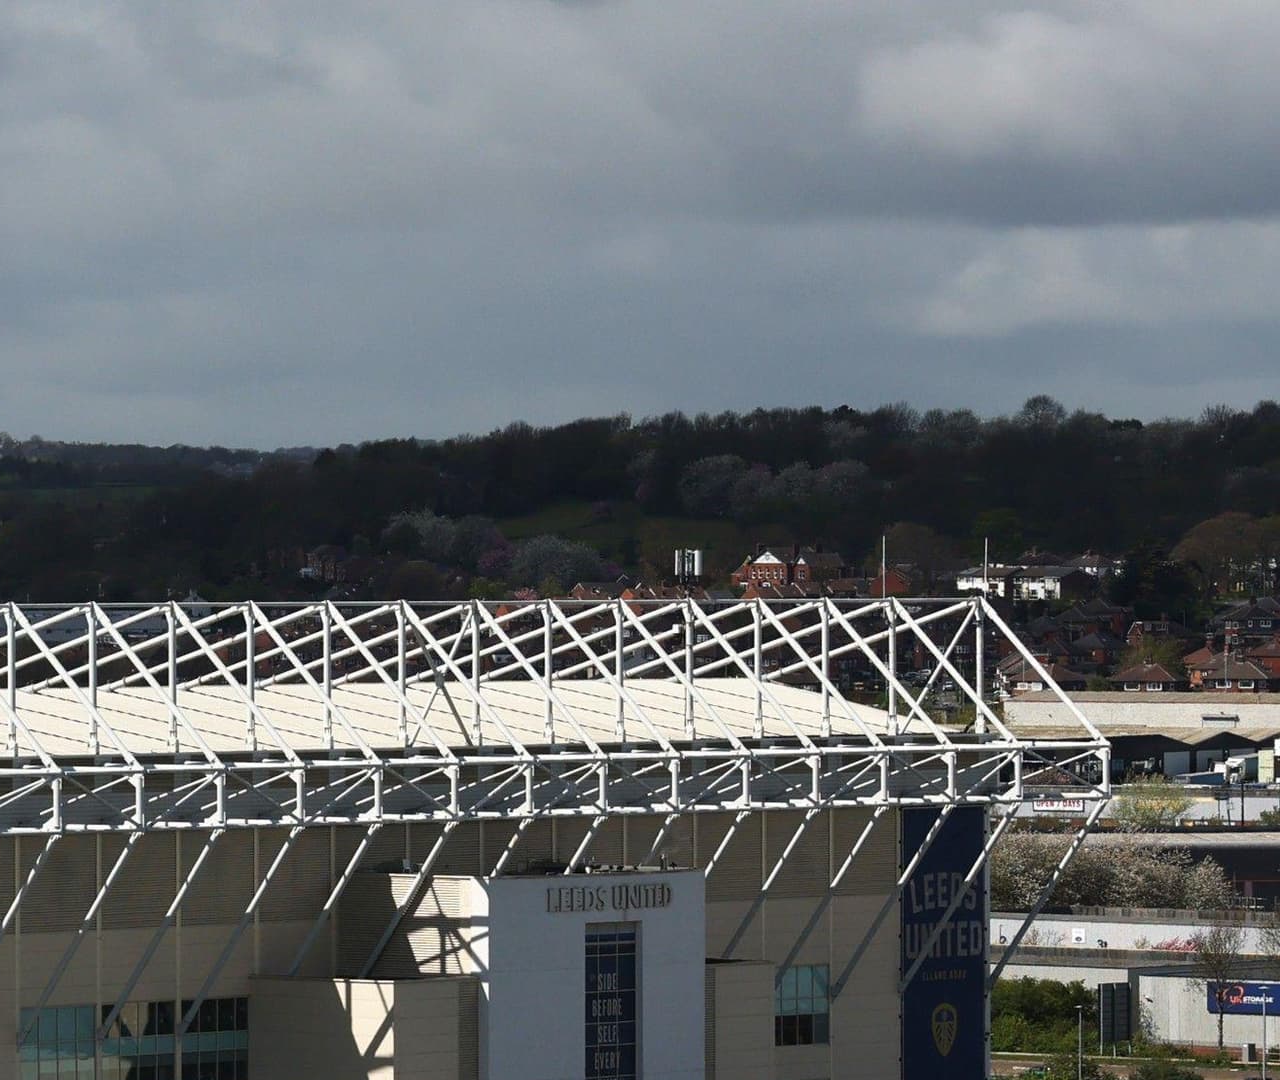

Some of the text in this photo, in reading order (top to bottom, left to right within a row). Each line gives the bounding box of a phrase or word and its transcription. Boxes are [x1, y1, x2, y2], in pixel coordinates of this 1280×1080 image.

[547, 882, 672, 912] LEEDS UNITED
[910, 872, 978, 914] LEEDS
[905, 920, 983, 959] UNITED
[592, 999, 623, 1017] BEFORE
[594, 1052, 622, 1070] EVERY
